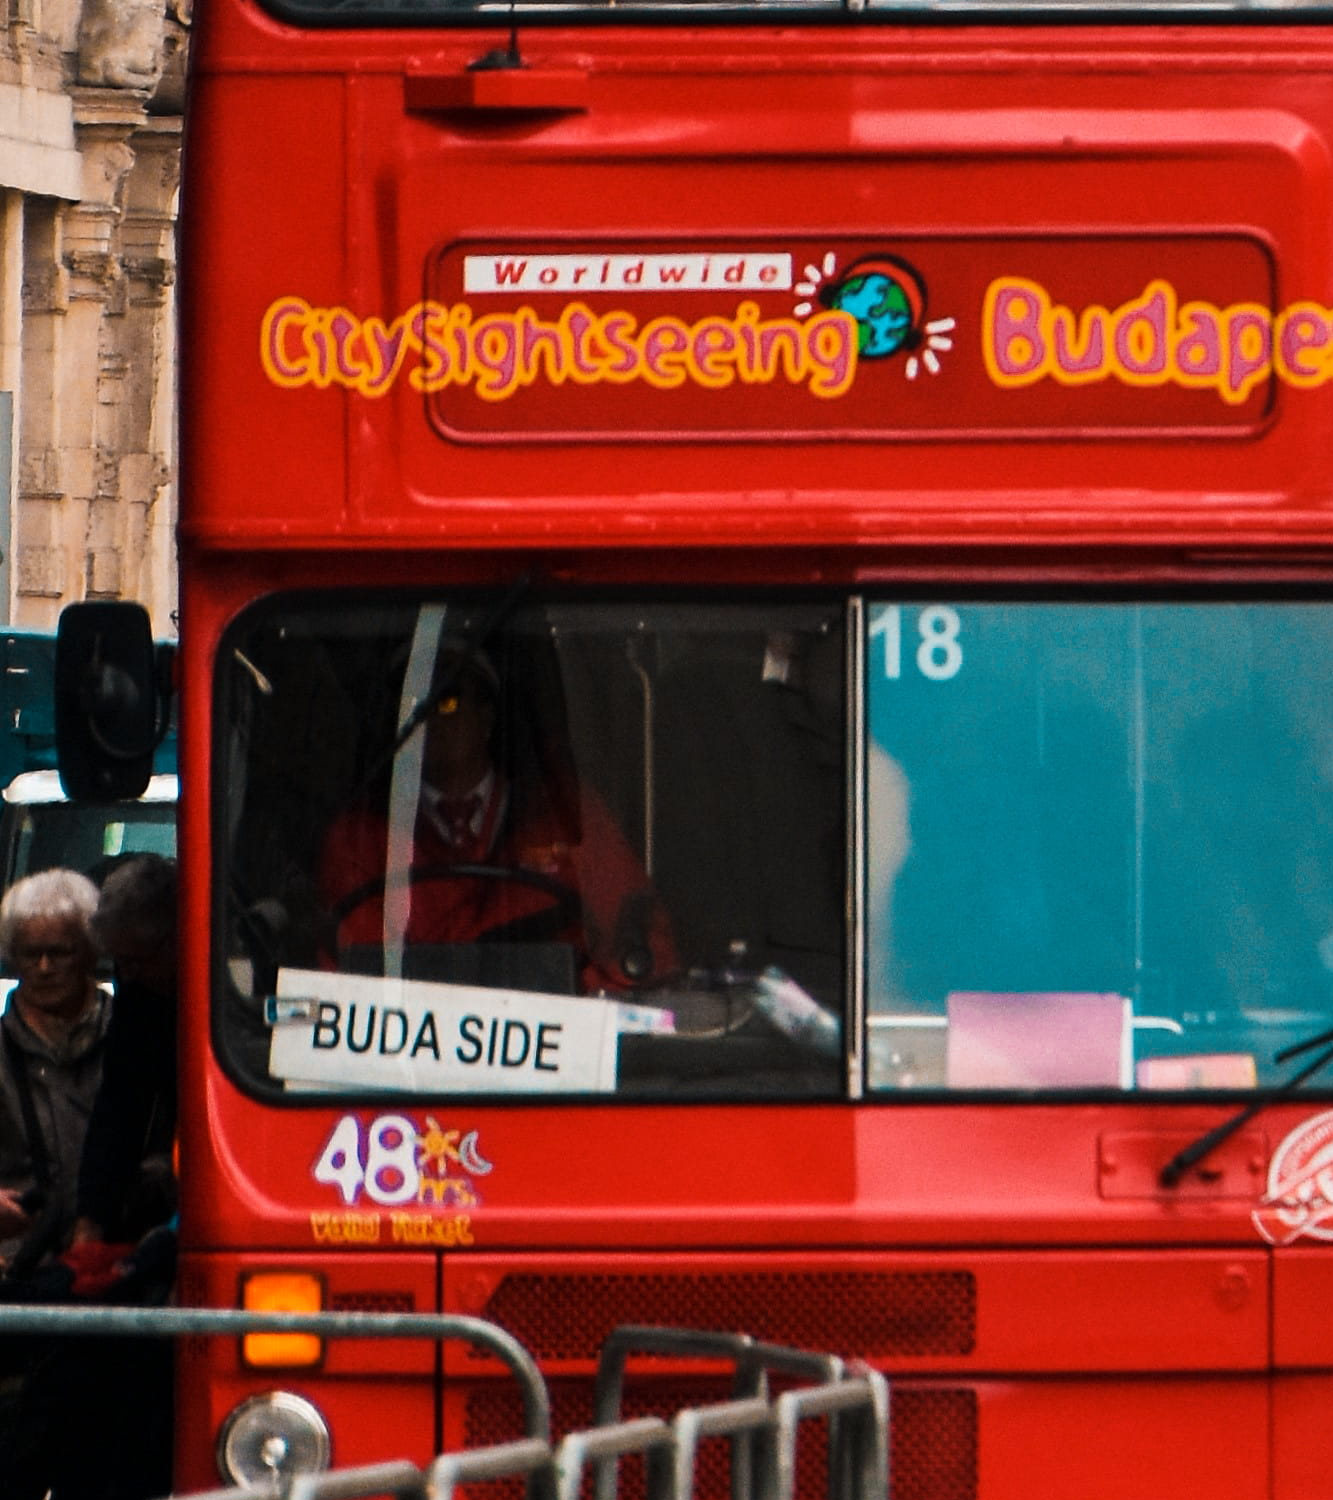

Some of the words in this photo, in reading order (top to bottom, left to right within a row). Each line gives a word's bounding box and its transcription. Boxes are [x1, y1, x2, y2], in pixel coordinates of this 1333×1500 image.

[494, 257, 780, 285] Worldwide
[868, 605, 963, 680] 18
[313, 1002, 441, 1060] BUDA
[456, 1014, 564, 1072] SIDE
[313, 1114, 421, 1206] 48
